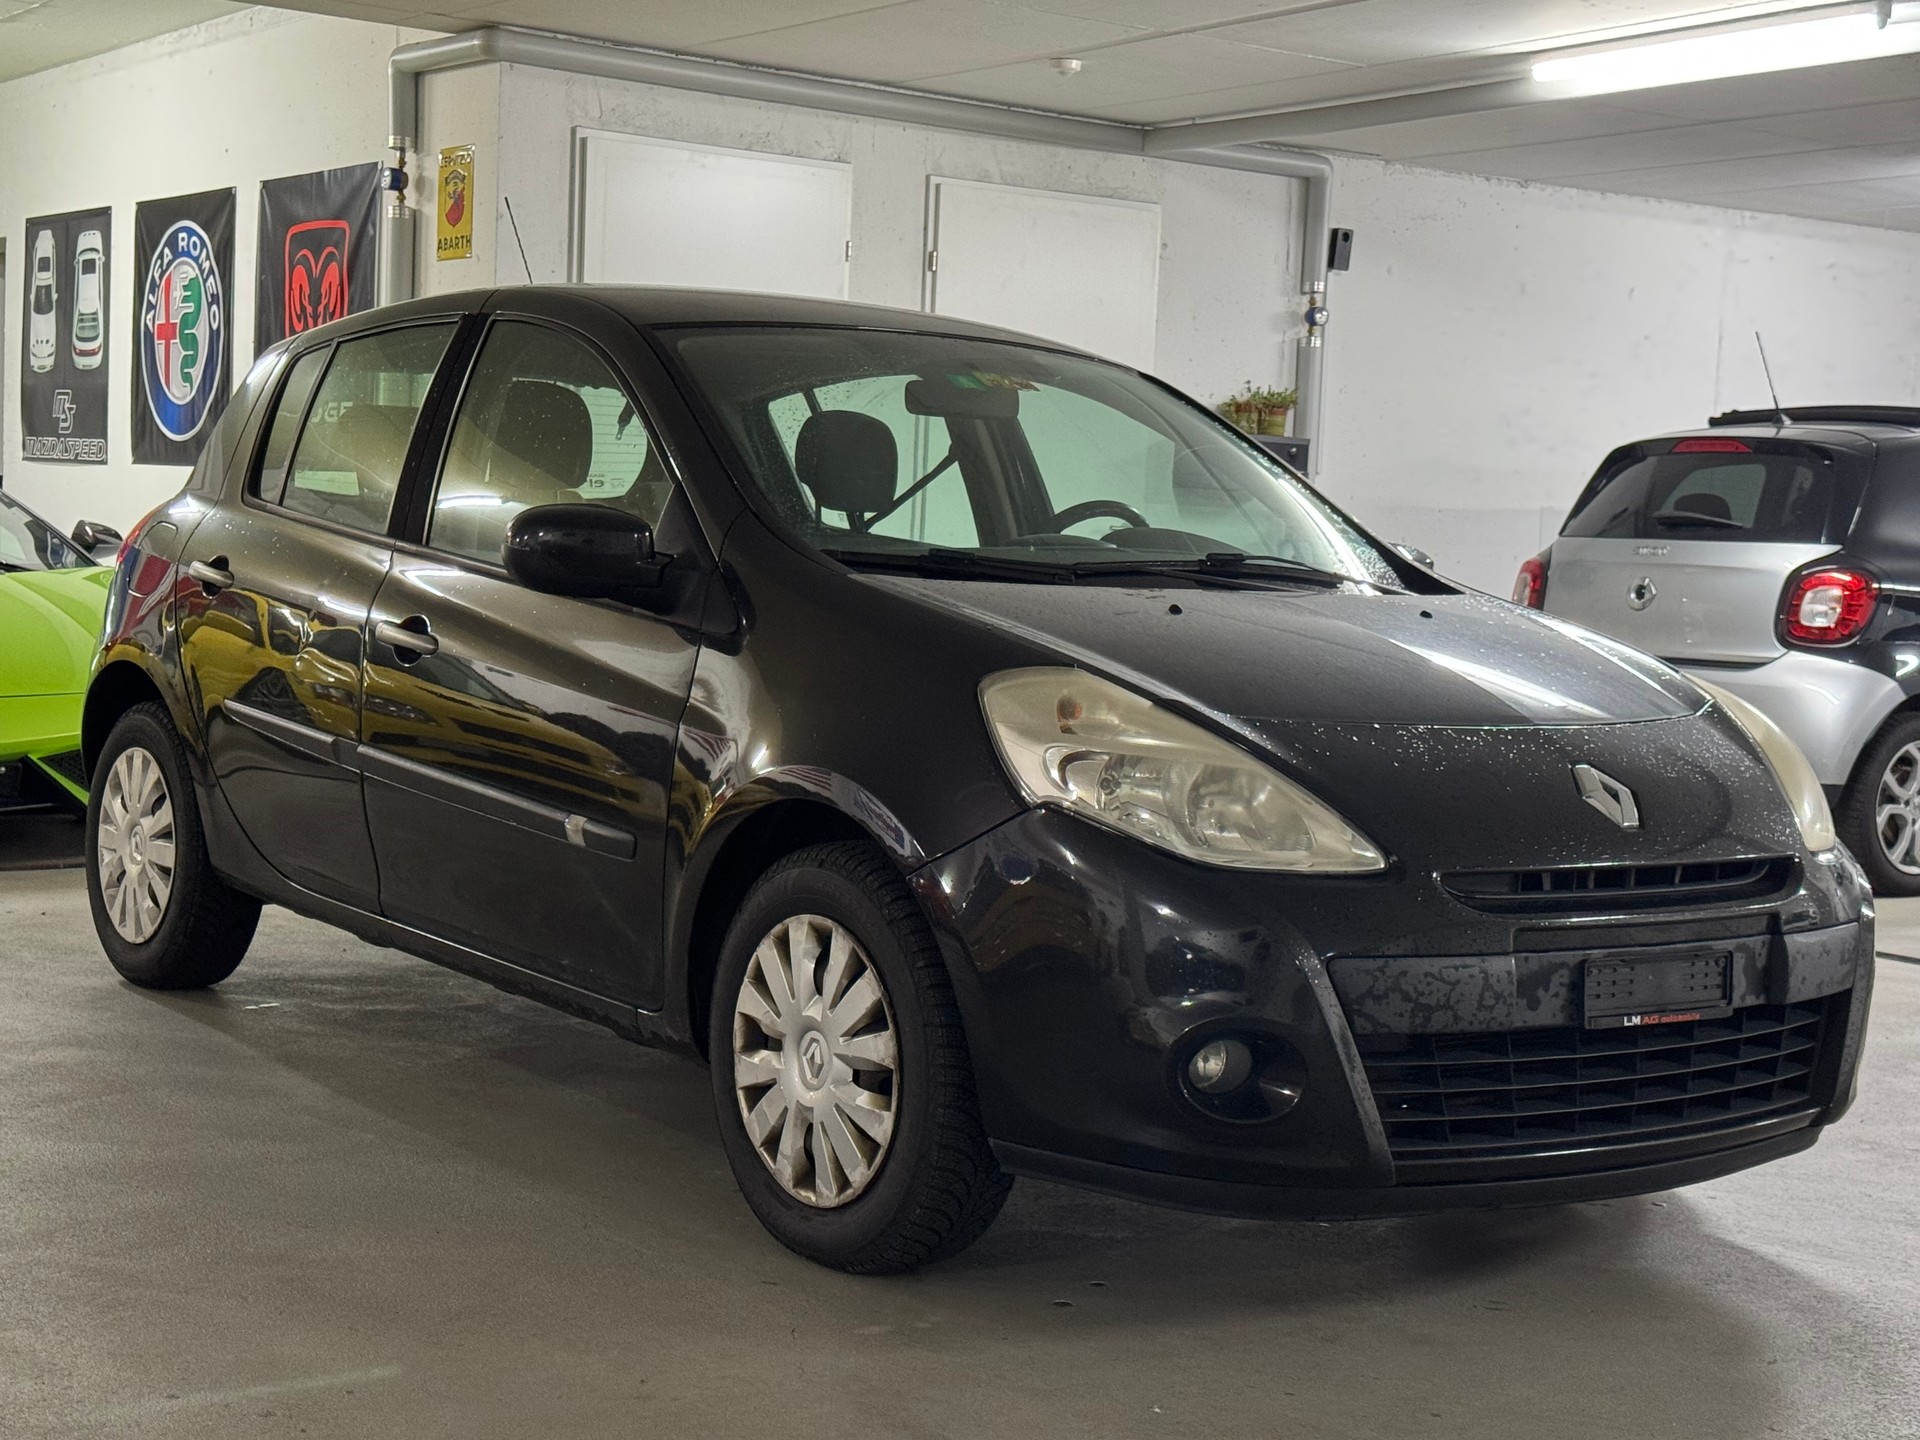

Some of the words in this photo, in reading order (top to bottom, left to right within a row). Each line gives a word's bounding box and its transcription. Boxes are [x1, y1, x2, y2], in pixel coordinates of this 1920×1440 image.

[437, 234, 472, 252] ABARTH
[146, 246, 173, 333] ALFA
[178, 232, 219, 331] ROMEO
[24, 436, 106, 461] MAZDASPEED
[1623, 1015, 1641, 1026] LM
